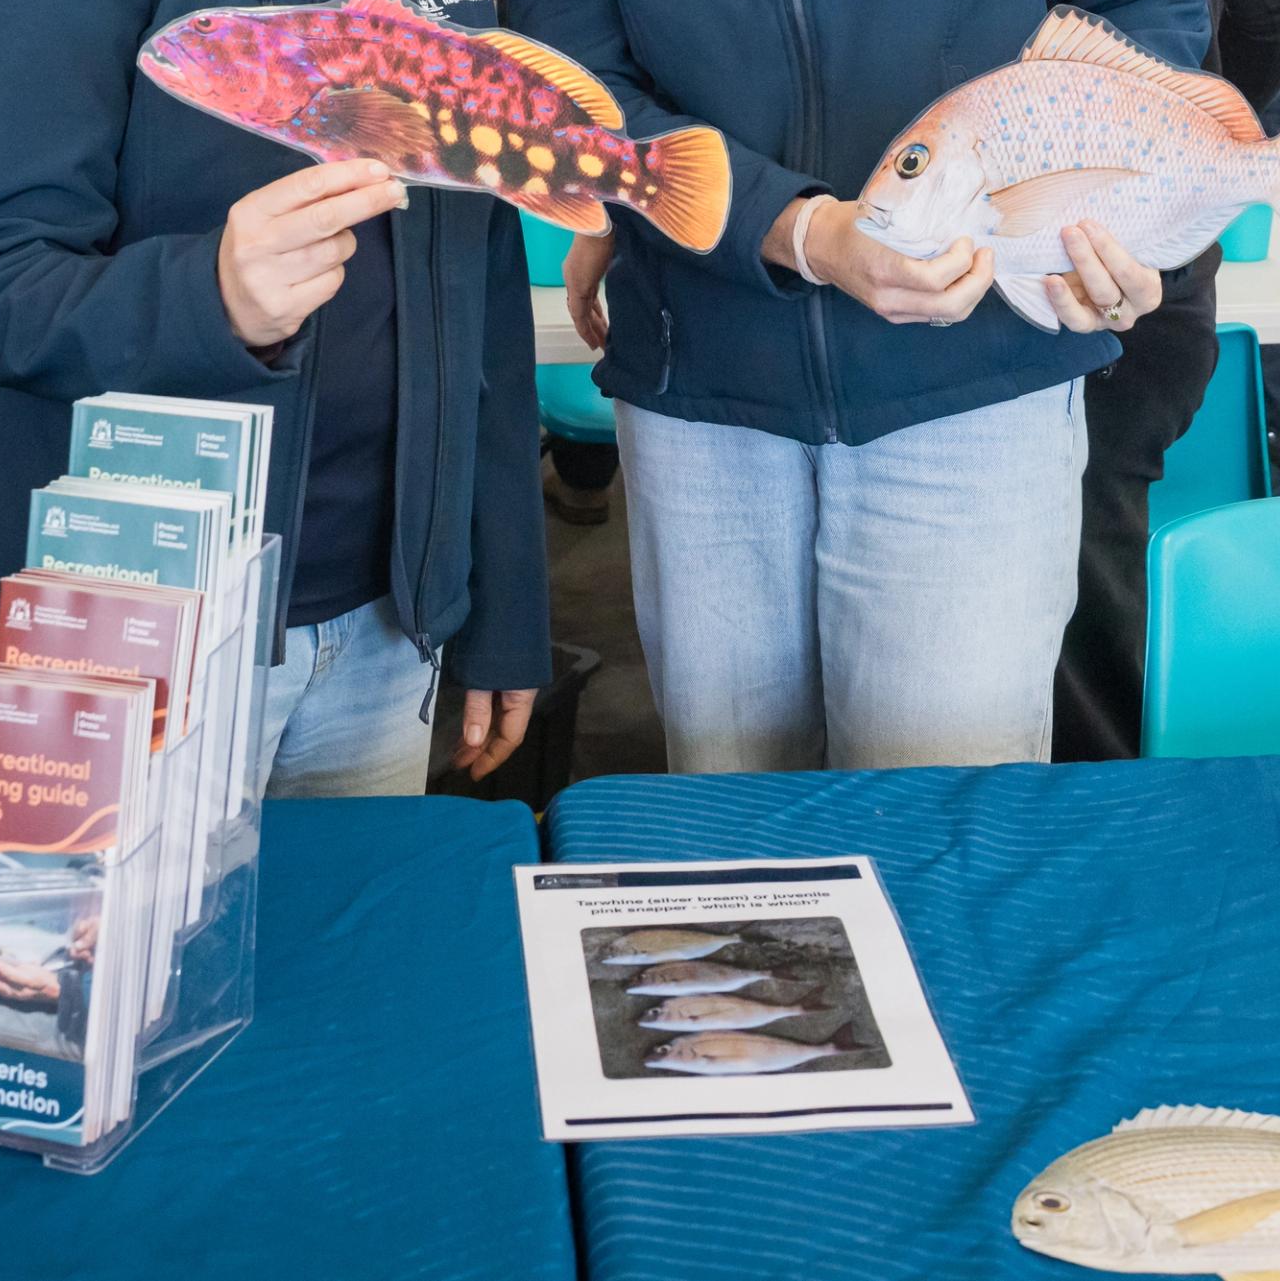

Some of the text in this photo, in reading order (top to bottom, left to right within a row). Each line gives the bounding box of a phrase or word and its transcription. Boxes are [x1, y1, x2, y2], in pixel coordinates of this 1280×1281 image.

[42, 555, 158, 584] Recreational
[6, 646, 139, 678] Recreational
[27, 783, 89, 807] guide
[576, 899, 644, 907] Tarwhine
[773, 890, 830, 900] juvenile
[591, 907, 622, 916] pink
[627, 905, 687, 914] snapper
[702, 902, 746, 911] which
[768, 898, 820, 908] which?
